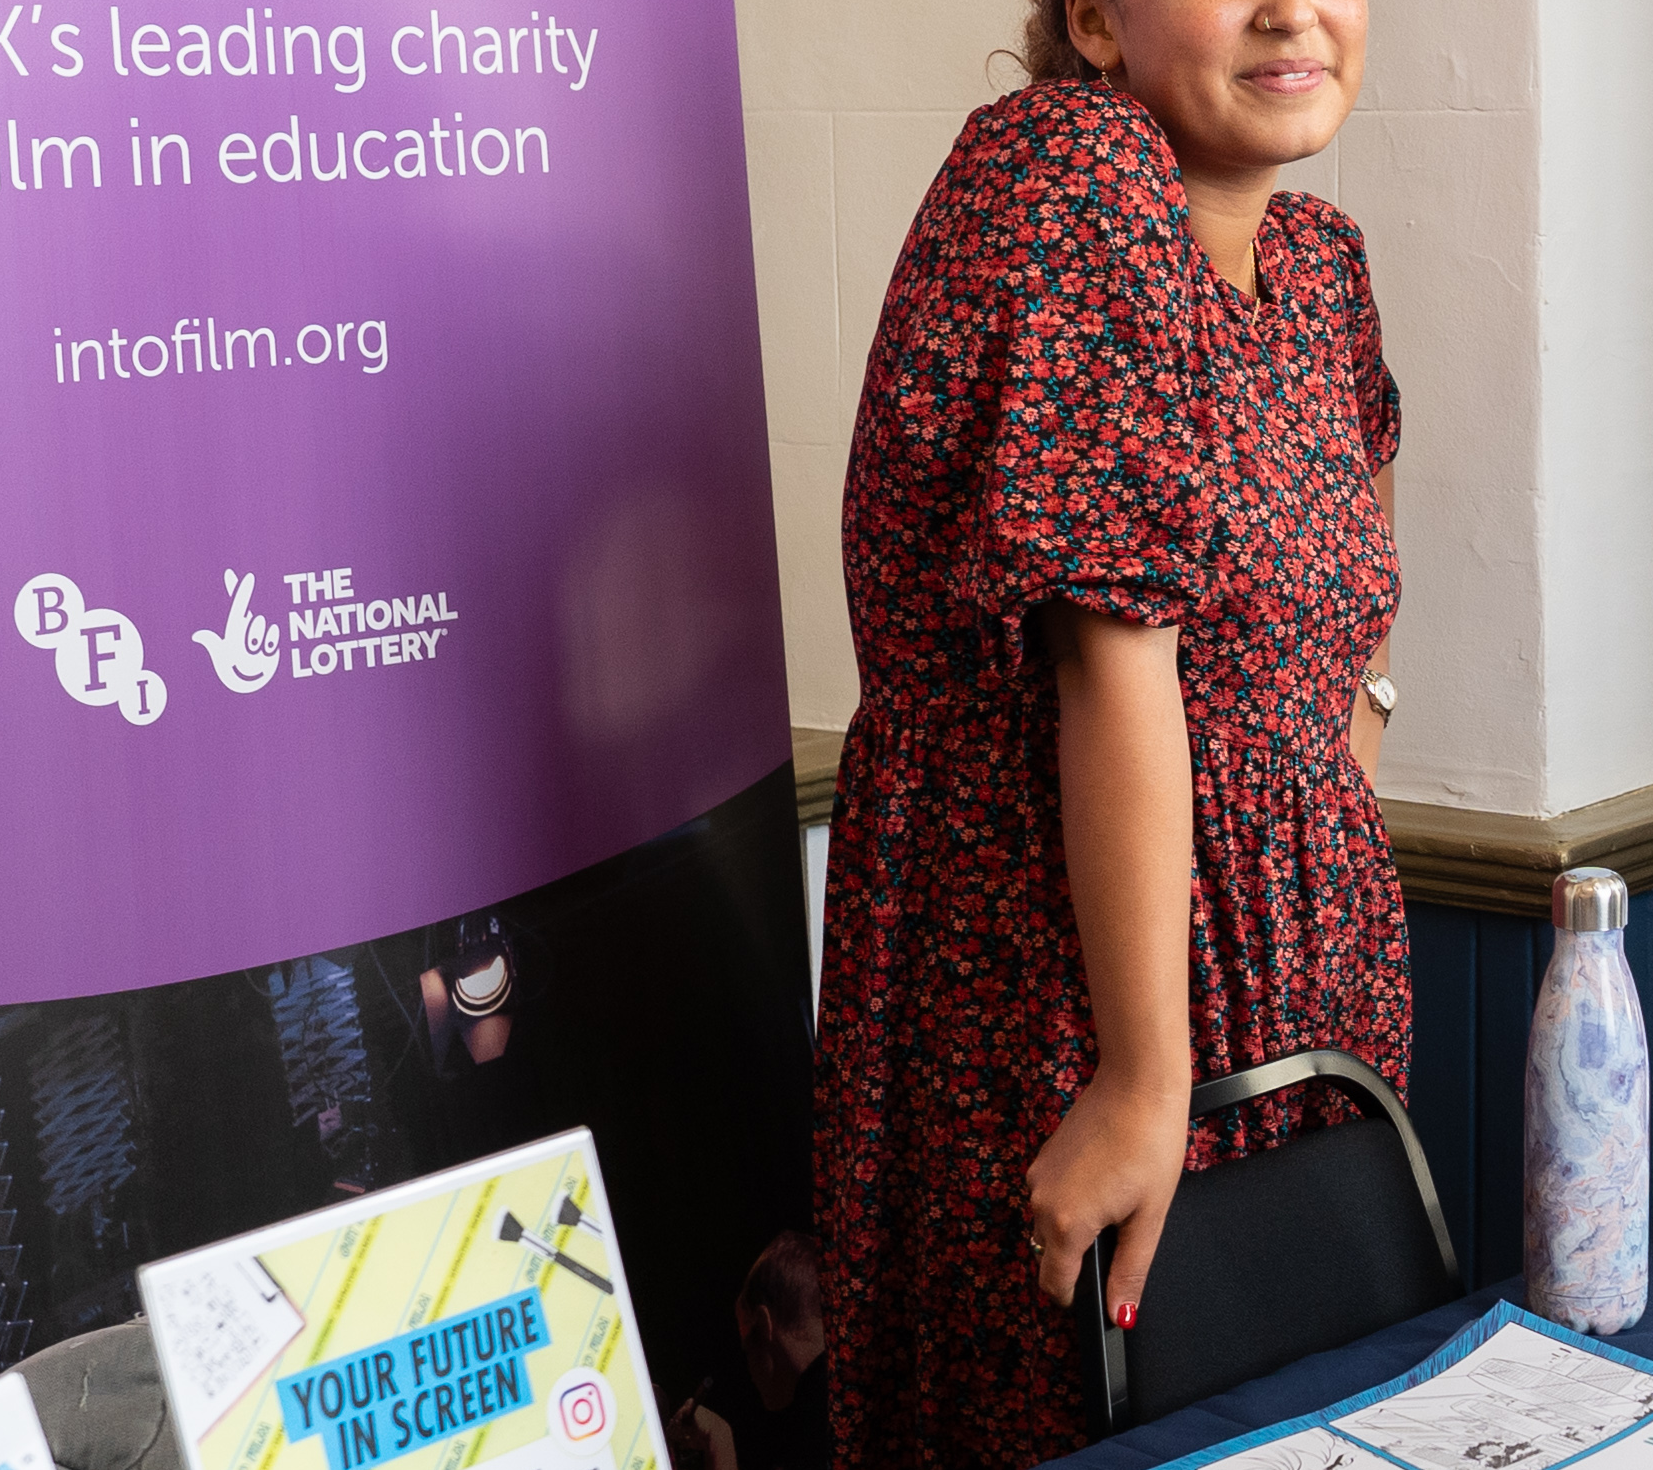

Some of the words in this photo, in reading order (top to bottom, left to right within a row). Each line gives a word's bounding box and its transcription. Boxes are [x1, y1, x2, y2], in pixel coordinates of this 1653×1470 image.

[111, 6, 365, 93] leading
[390, 11, 597, 92] charity
[130, 118, 191, 187] in
[217, 111, 550, 184] education
[53, 315, 389, 385] intofilm.org
[283, 566, 354, 604] THE
[289, 592, 458, 641] NATIONAL
[27, 581, 155, 717] BFI
[292, 1352, 396, 1428] YOUR
[410, 1297, 539, 1387] FUTURE
[338, 1412, 378, 1470] IN
[393, 1357, 518, 1448] SCREEN
